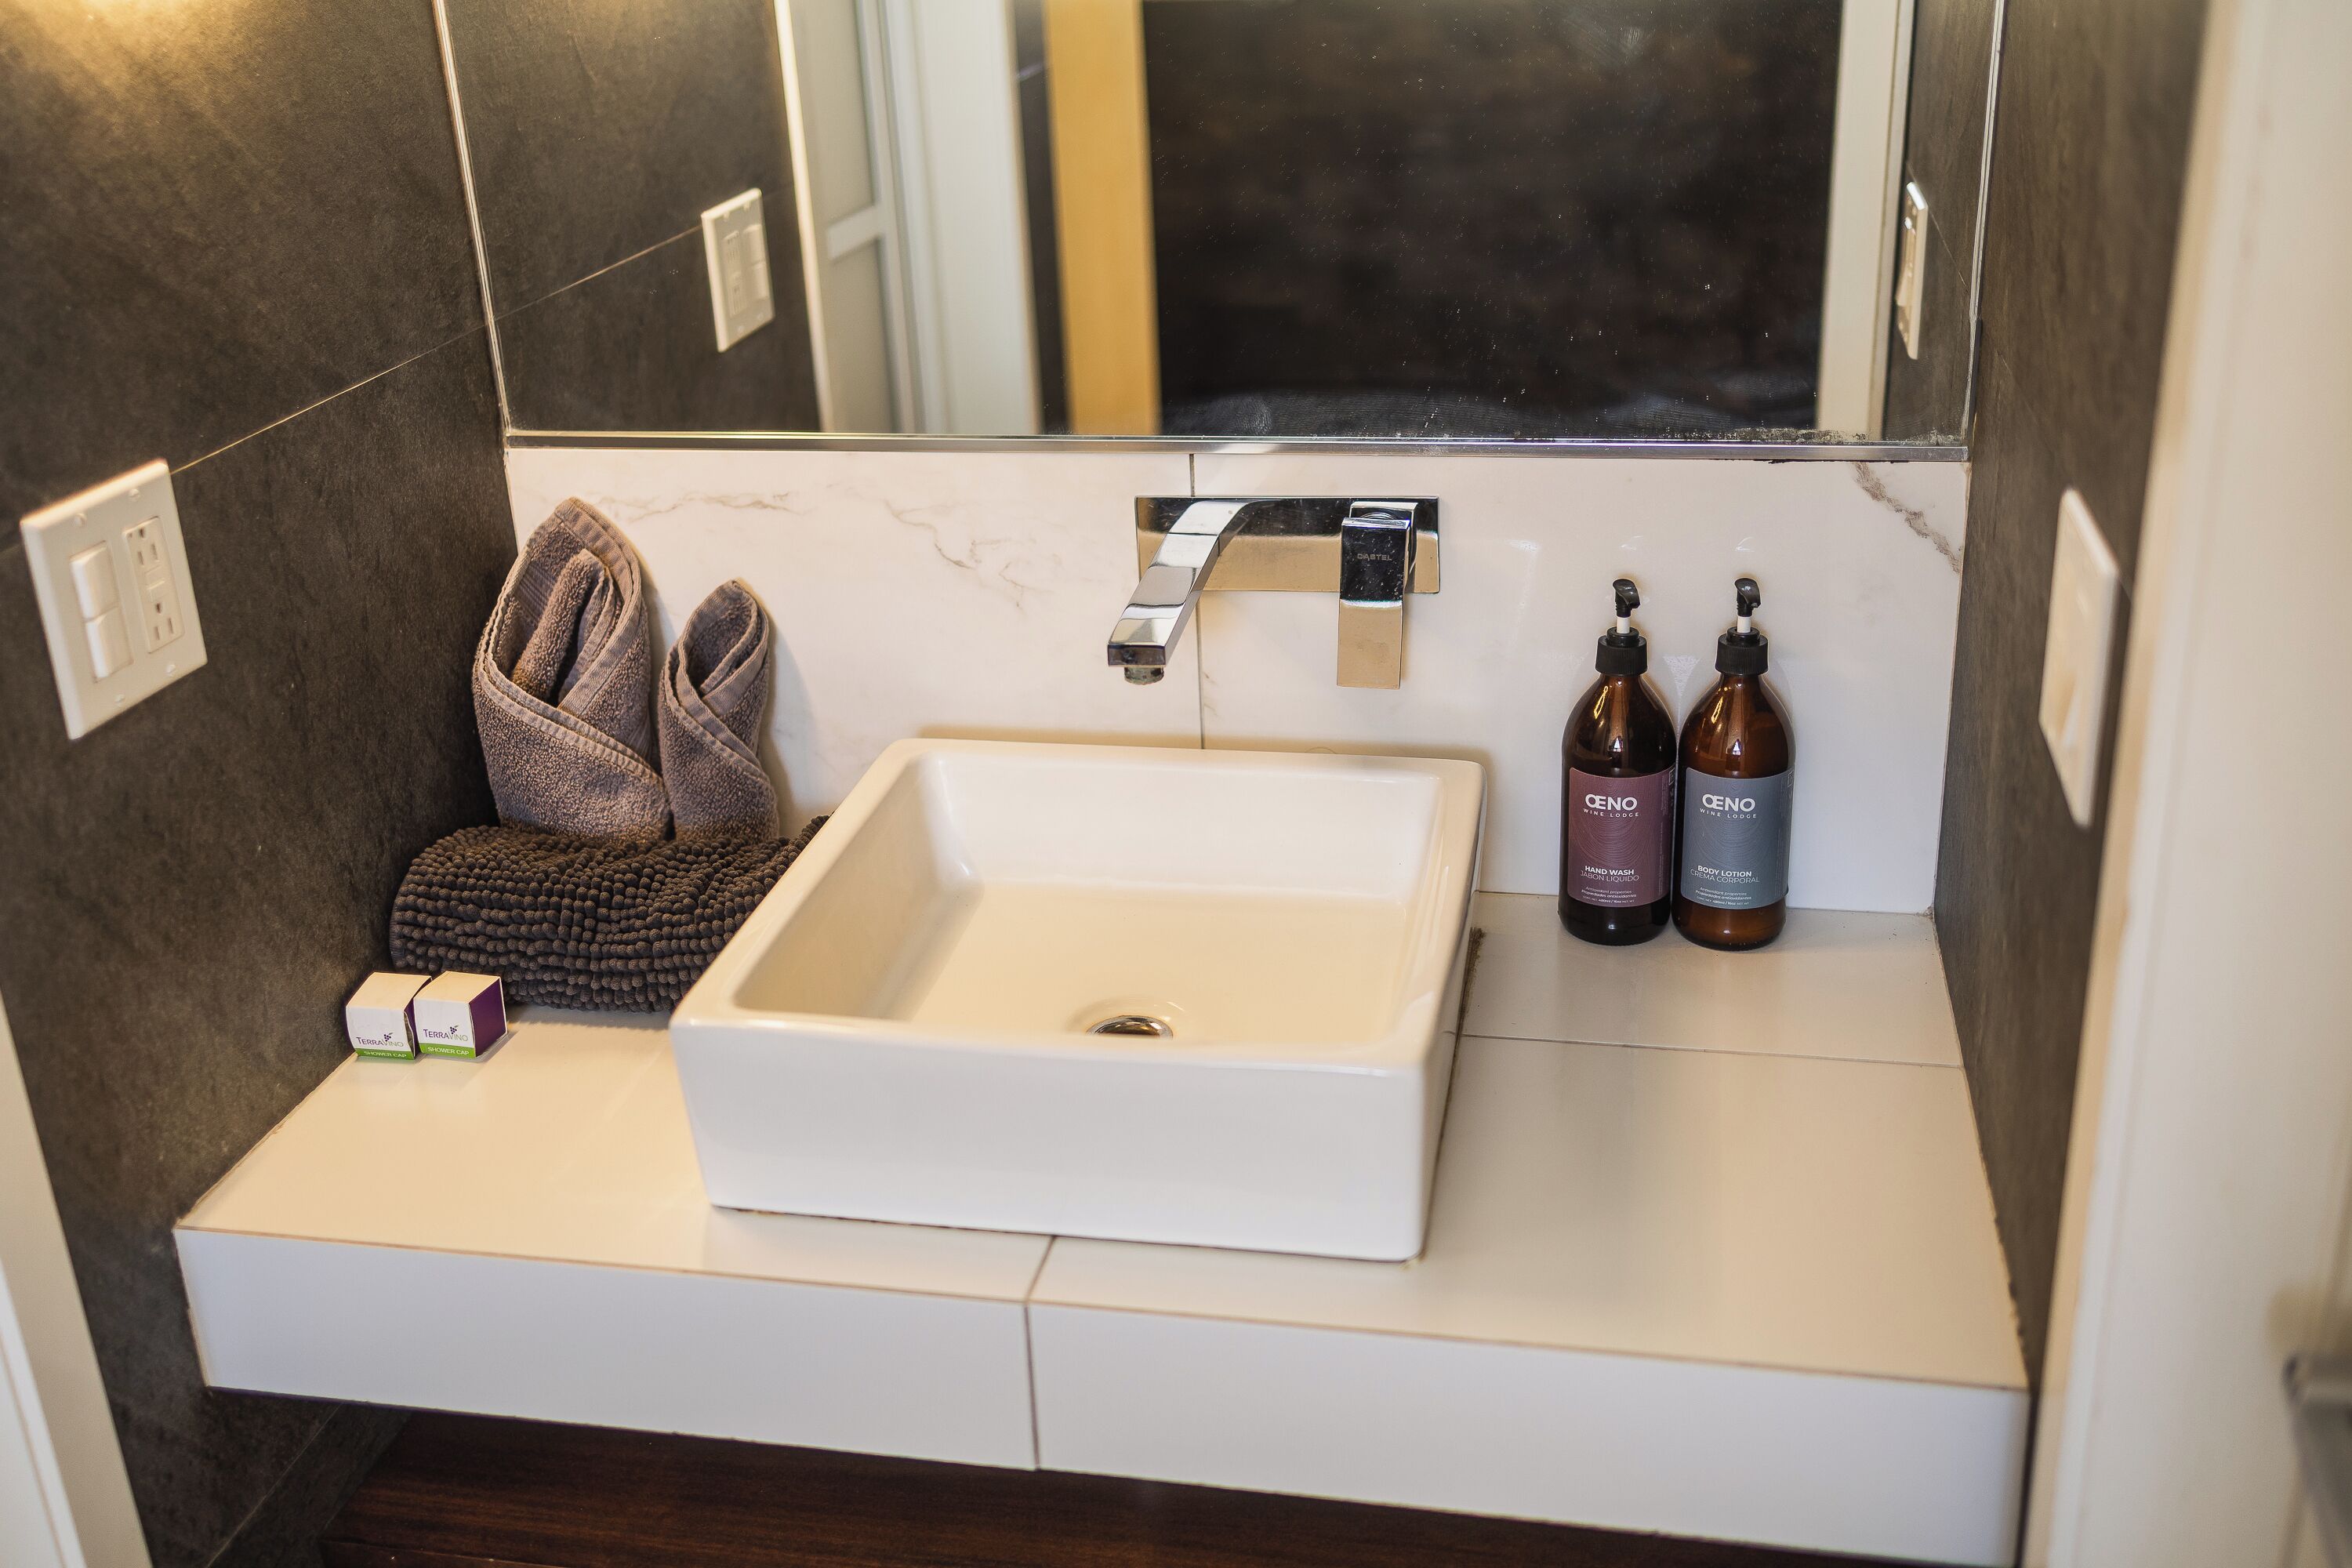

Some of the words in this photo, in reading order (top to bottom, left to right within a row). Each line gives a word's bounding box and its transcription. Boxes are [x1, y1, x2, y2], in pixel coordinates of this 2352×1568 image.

[1585, 793, 1638, 811] ŒNO
[1702, 793, 1755, 812] ŒNO
[1583, 808, 1604, 817] WINE
[1700, 808, 1721, 817] WINE
[1581, 870, 1604, 880] JABON
[1585, 866, 1607, 875] HAND
[1690, 869, 1715, 881] CREMA
[1697, 865, 1719, 875] BODY
